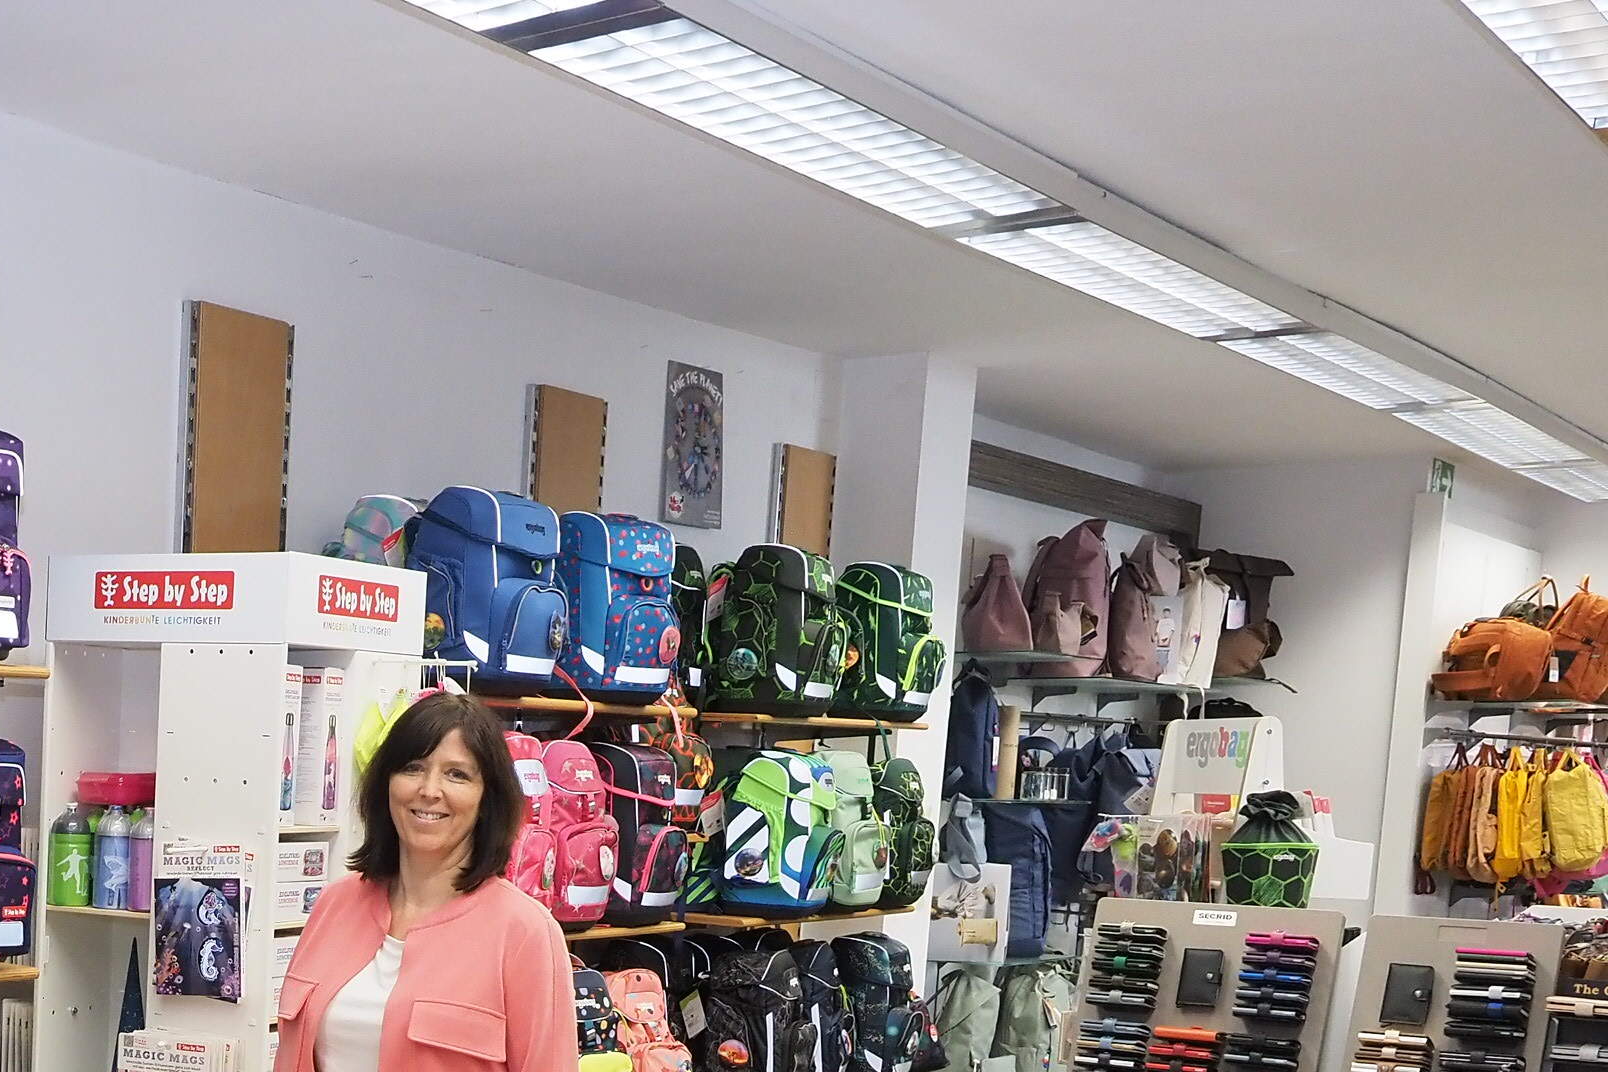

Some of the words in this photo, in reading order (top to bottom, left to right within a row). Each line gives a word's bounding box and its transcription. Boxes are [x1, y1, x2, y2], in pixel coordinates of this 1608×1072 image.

[123, 576, 159, 605] Step
[165, 577, 186, 607] by
[191, 576, 228, 605] Step
[335, 587, 356, 611] Step
[361, 584, 373, 613] by
[374, 592, 395, 618] Step
[103, 615, 160, 625] KINDERBUNTE
[163, 616, 221, 625] LEICHTIGKEIT
[1186, 727, 1250, 768] ergobag
[163, 856, 203, 865] MAGIC
[207, 856, 241, 865] MAGS
[1574, 984, 1599, 995] The
[123, 1048, 165, 1061] MAGIC
[170, 1053, 206, 1066] MAGS
